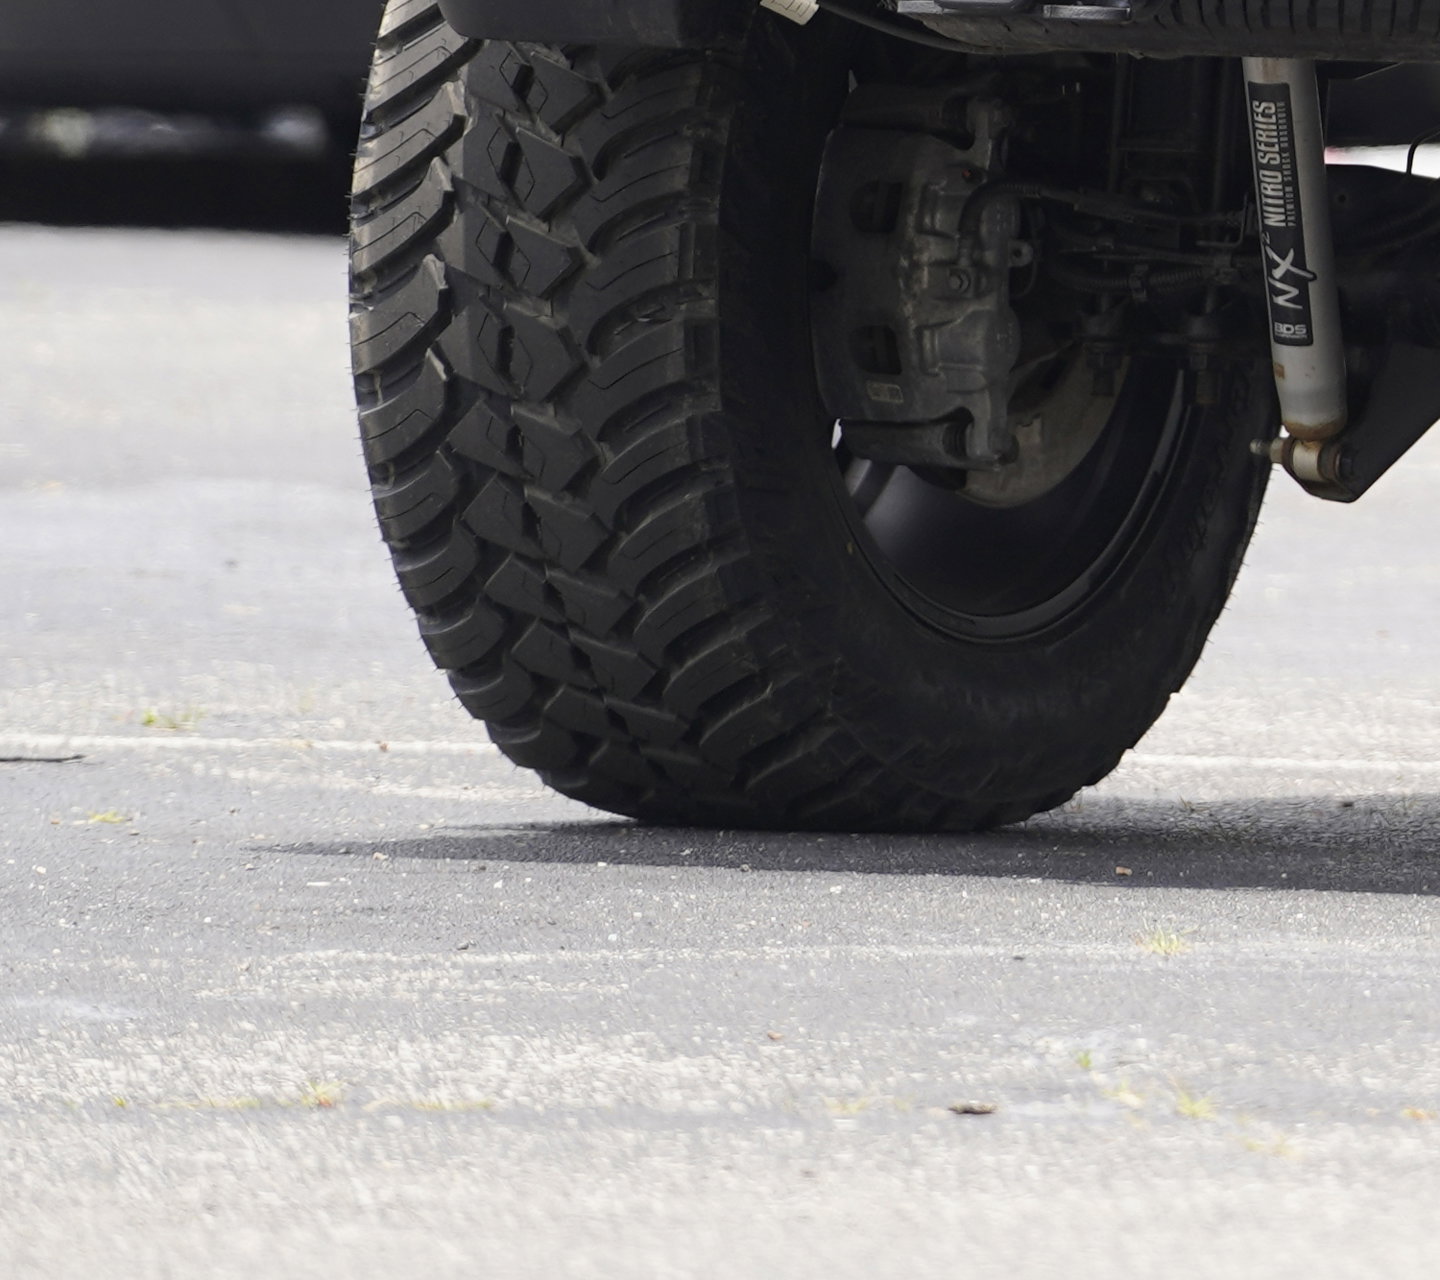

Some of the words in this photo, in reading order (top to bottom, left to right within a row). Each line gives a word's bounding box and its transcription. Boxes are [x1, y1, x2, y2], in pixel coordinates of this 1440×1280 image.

[1252, 100, 1280, 165] SERIES
[1259, 170, 1286, 227] NITRO
[1274, 322, 1307, 335] BDS
